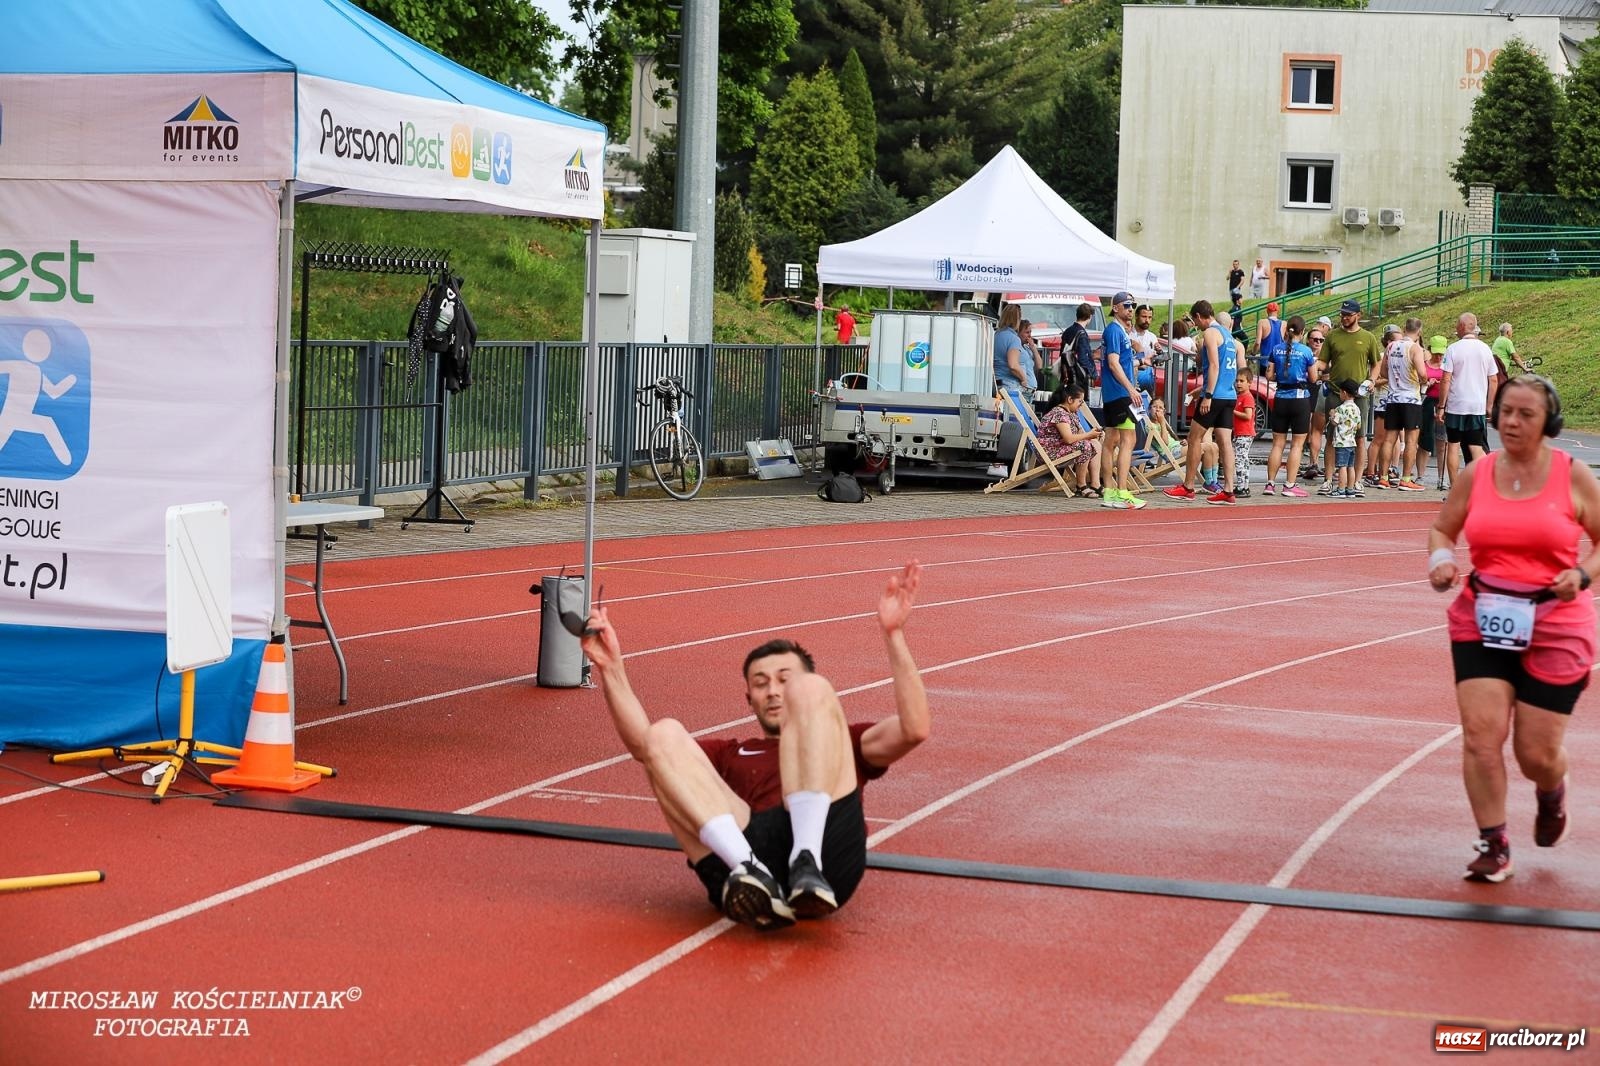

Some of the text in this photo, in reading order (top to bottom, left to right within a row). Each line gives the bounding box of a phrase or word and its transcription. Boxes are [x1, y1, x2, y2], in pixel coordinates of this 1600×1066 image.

[163, 126, 239, 150] MITKO
[320, 108, 444, 170] PersonalBest
[163, 153, 239, 162] for events
[564, 169, 590, 191] MITKO
[956, 263, 1013, 275] Wodociągi
[956, 273, 1013, 283] Raciborskie
[0, 517, 61, 539] GOWE
[0, 552, 68, 599] t.pl
[1481, 615, 1515, 635] 260
